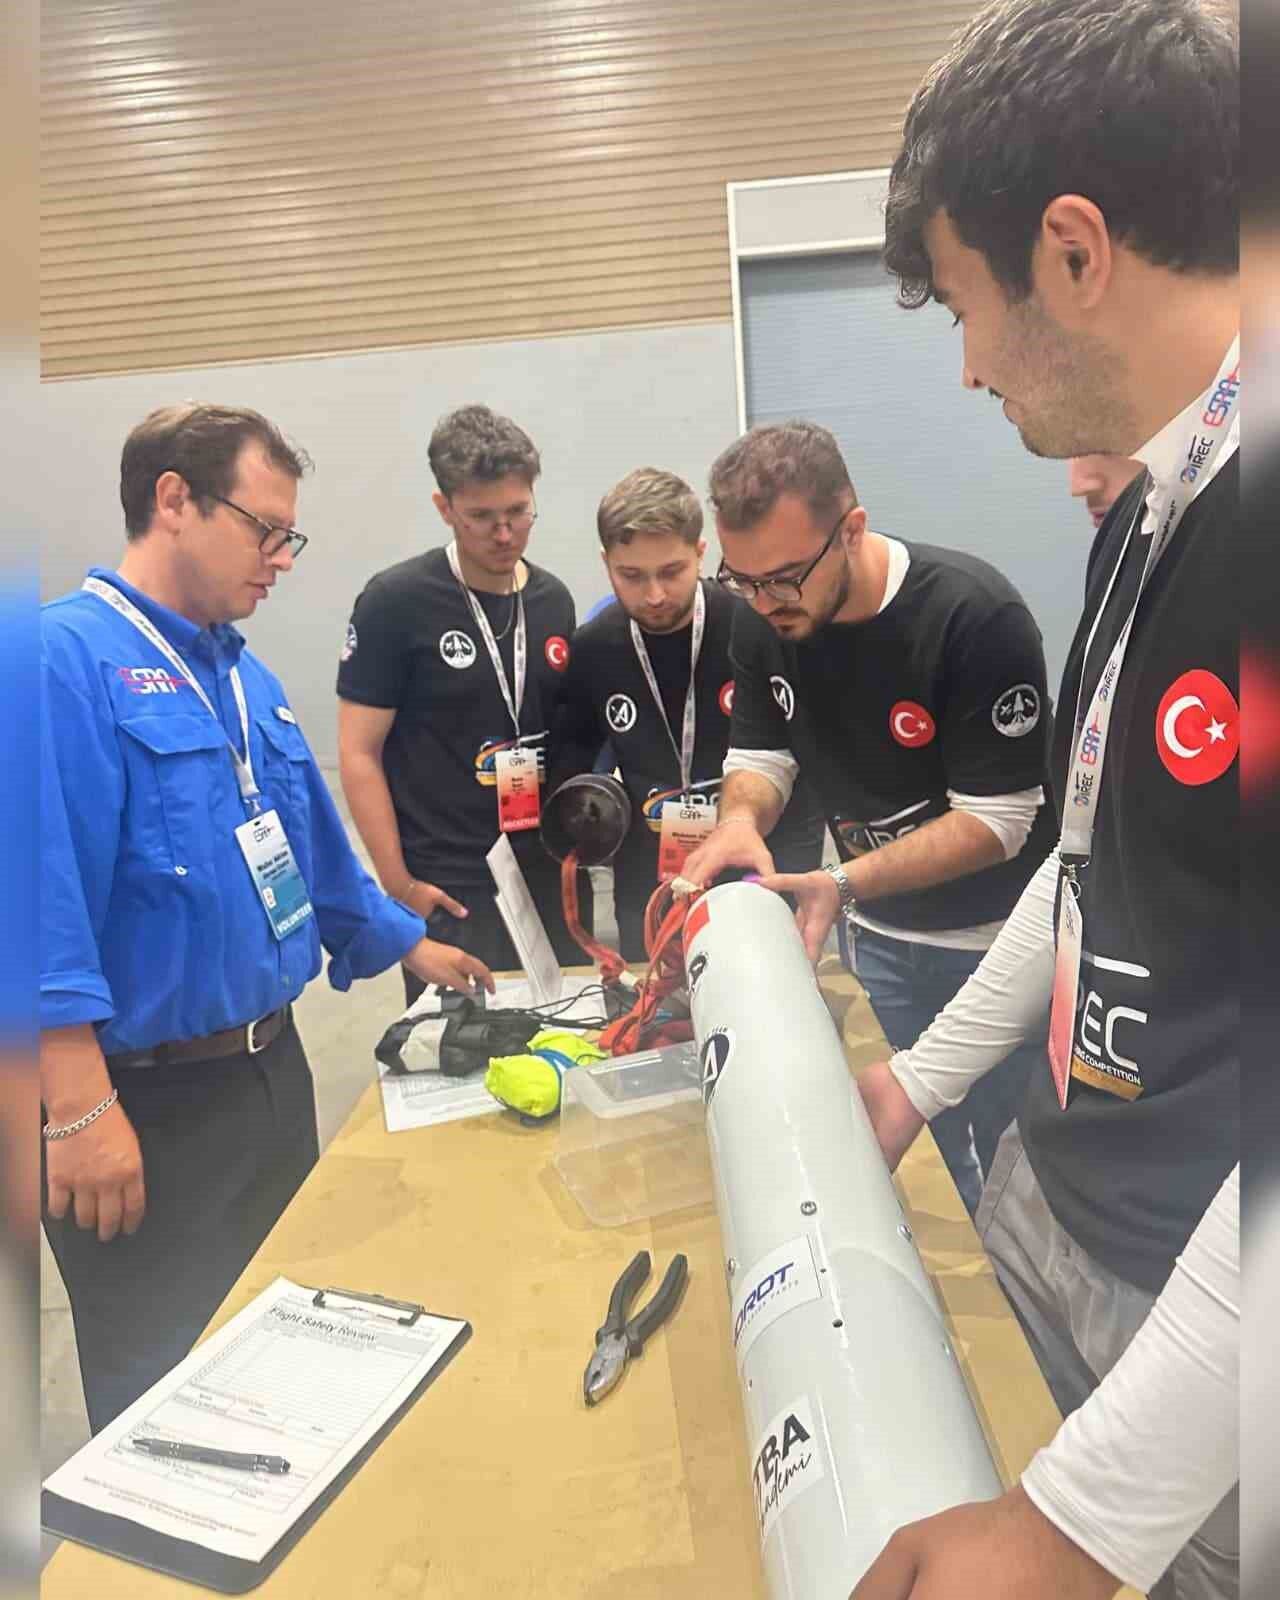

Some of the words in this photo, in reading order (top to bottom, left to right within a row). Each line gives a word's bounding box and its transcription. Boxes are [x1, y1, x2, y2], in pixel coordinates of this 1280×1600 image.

[1191, 437, 1214, 470] IREC
[1104, 662, 1117, 690] IREC
[1081, 773, 1094, 799] IREC
[1080, 989, 1149, 1073] EC
[1085, 1054, 1142, 1087] COMPETITION
[302, 1316, 335, 1334] Safety
